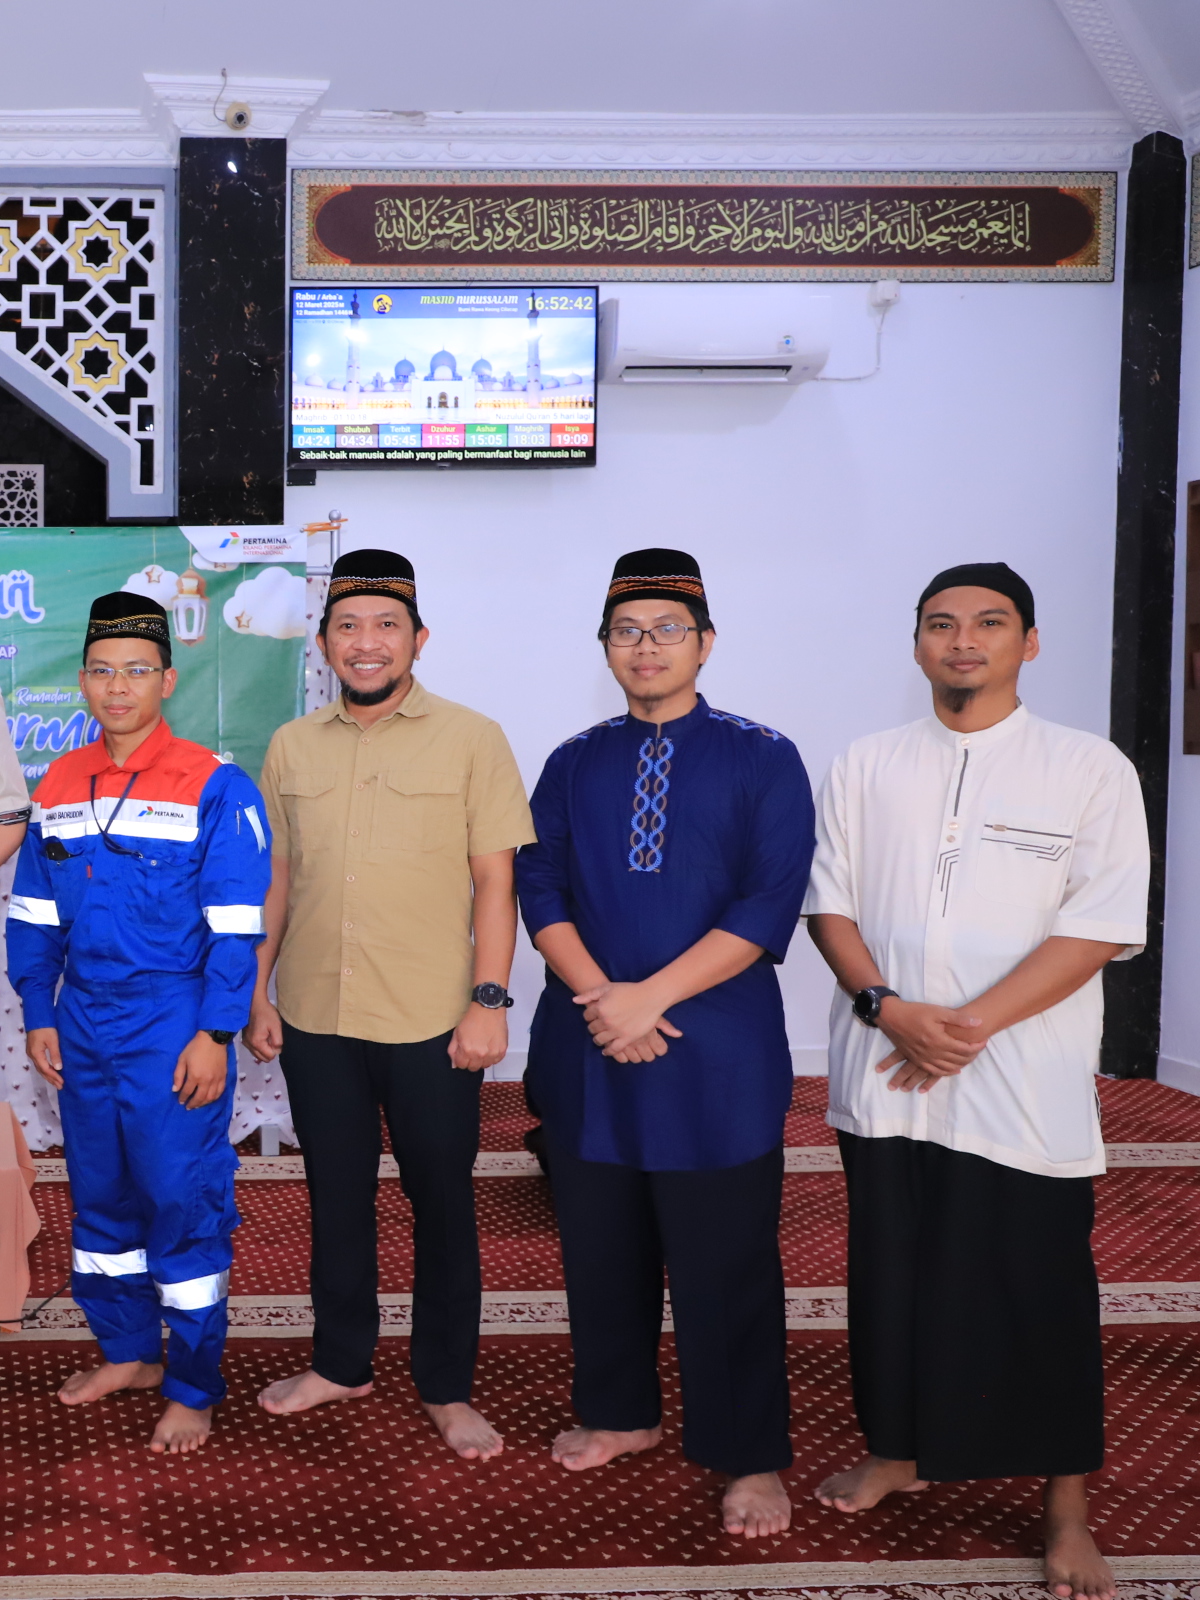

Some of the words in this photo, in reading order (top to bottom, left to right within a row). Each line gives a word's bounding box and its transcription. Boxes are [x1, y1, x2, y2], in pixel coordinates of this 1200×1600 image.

[295, 292, 316, 301] Rabu
[420, 295, 455, 304] MASJID
[456, 295, 518, 304] NURUSSALAM
[526, 296, 593, 311] 16:52:42
[576, 412, 591, 422] lagi
[303, 426, 325, 434] Imsak
[343, 425, 371, 434] Shubuh
[390, 425, 411, 433] Terbit
[430, 425, 456, 434] Dzuhur
[475, 425, 497, 433] Ashar
[514, 425, 544, 434] Maghrib
[565, 425, 580, 433] Isya
[297, 435, 331, 447] 04:24
[340, 435, 374, 447] 04:34
[383, 435, 417, 447] 05:45
[427, 435, 460, 446] 11:55
[470, 434, 503, 446] 15:05
[513, 434, 545, 446] 18:03
[556, 434, 589, 445] 19:09
[300, 450, 347, 460] Sebaik-baik
[348, 451, 384, 459] manusia
[386, 450, 415, 459] adalah
[415, 451, 437, 460] yang
[437, 450, 463, 460] paling
[464, 450, 513, 459] bermanfaat
[513, 450, 532, 460] bagi
[533, 450, 569, 458] manusia
[570, 450, 586, 458] lain
[16, 687, 72, 707] Ramadan
